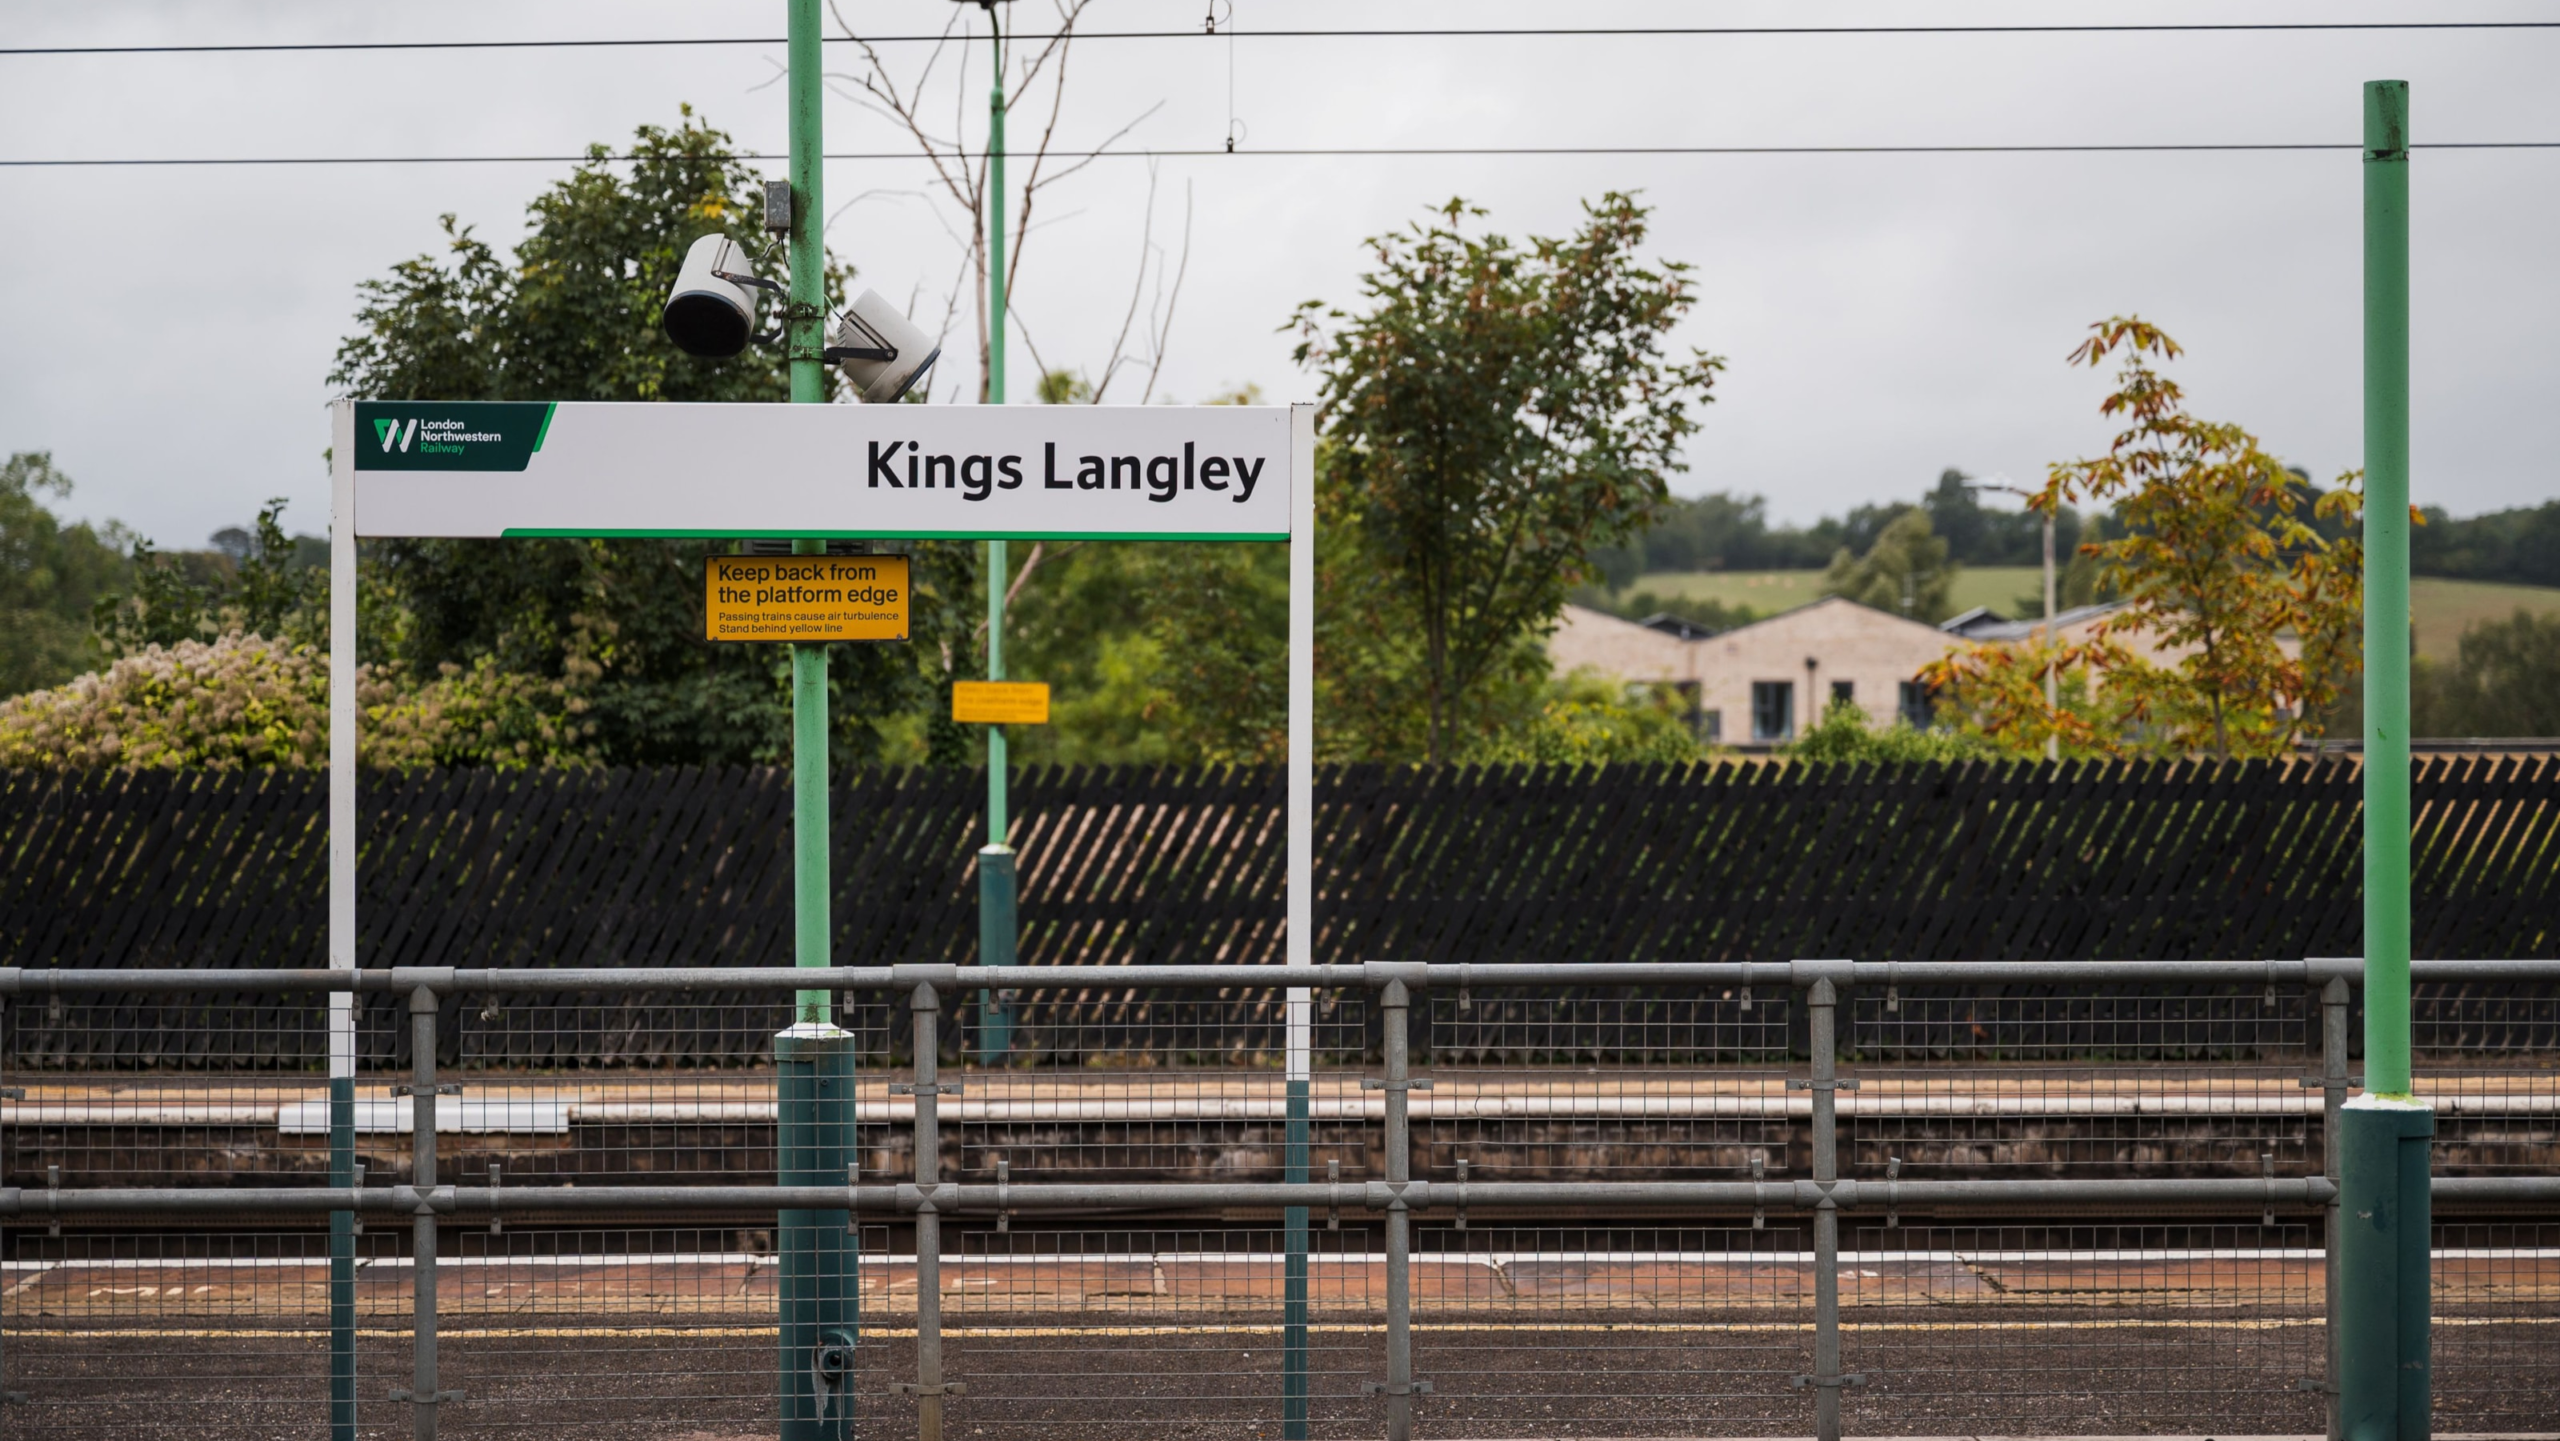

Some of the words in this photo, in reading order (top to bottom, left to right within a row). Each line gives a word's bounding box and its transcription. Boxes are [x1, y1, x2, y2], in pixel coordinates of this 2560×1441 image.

[420, 418, 465, 430] London
[420, 430, 502, 442] Northwestern
[420, 442, 465, 456] Railway
[867, 440, 1023, 502] Kings
[1044, 440, 1266, 504] Langley
[718, 564, 771, 585] Keep
[775, 563, 825, 582] back
[829, 563, 877, 581] from
[718, 586, 751, 604] the
[756, 586, 842, 607] platform
[847, 586, 899, 606] edge
[718, 612, 760, 623] Passing
[761, 612, 792, 622] trains
[793, 613, 826, 621] cause
[827, 611, 842, 621] air
[843, 611, 900, 621] turbulence
[718, 623, 750, 634] Stand
[751, 623, 787, 633] behind
[788, 623, 823, 635] yellow
[824, 623, 843, 633] line
